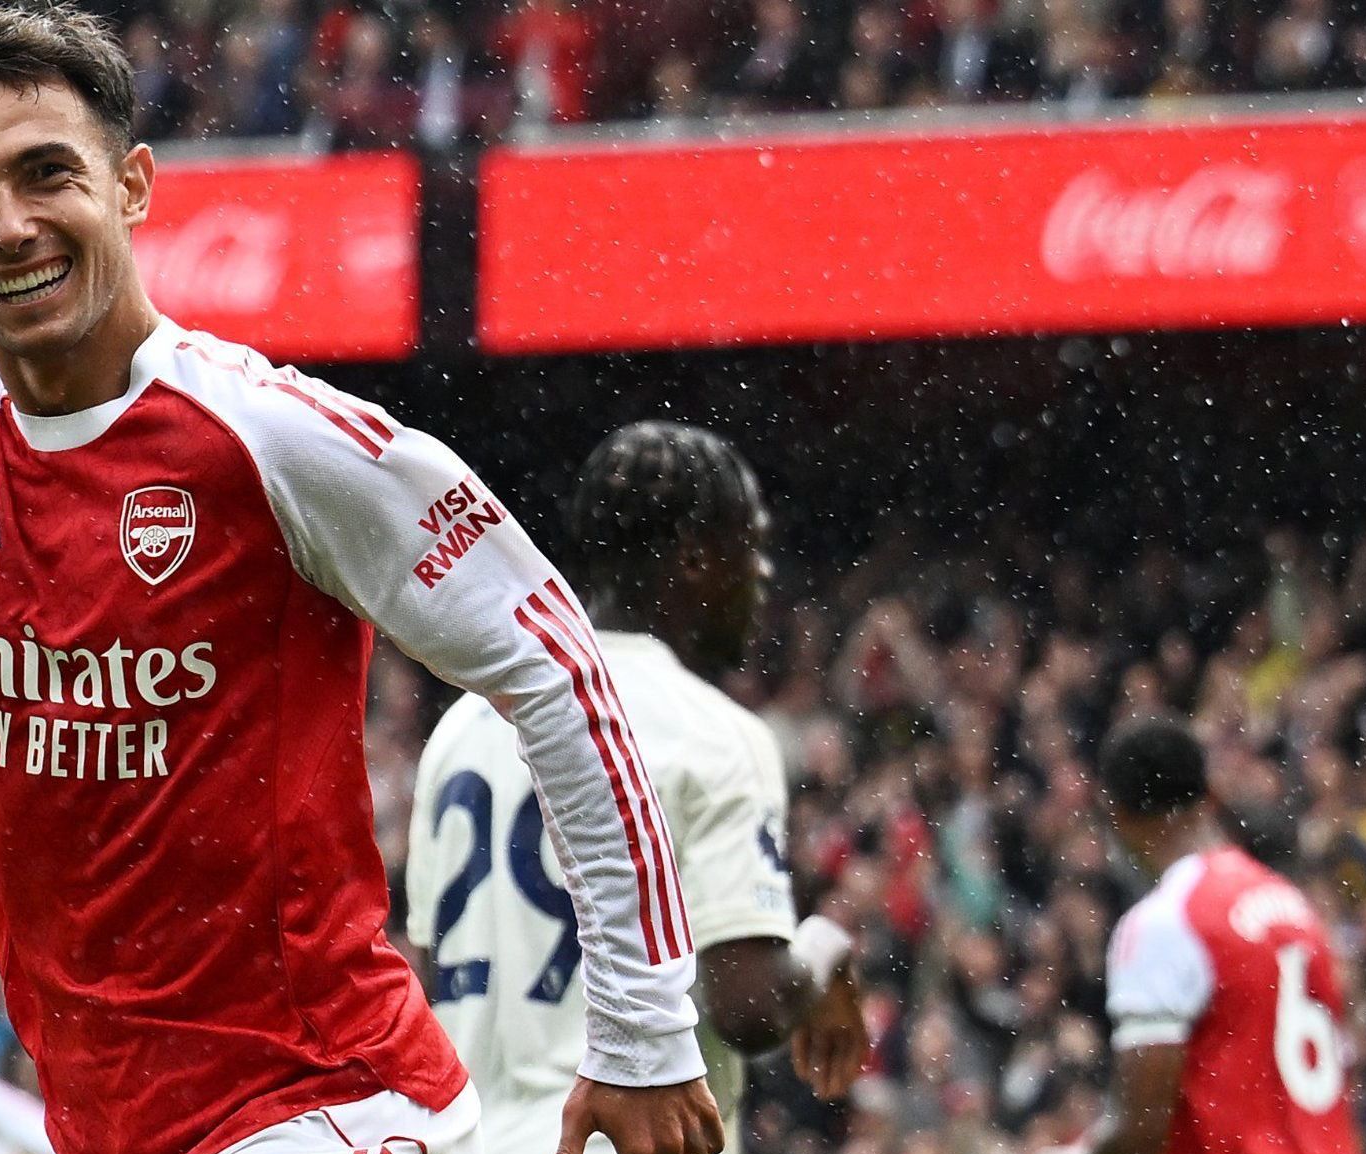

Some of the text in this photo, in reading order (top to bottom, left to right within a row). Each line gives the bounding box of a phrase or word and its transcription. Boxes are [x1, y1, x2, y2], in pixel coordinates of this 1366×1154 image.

[131, 503, 185, 519] Arsenal
[26, 716, 169, 781] BETTER
[432, 769, 584, 1005] 29
[1274, 942, 1343, 1116] 6
